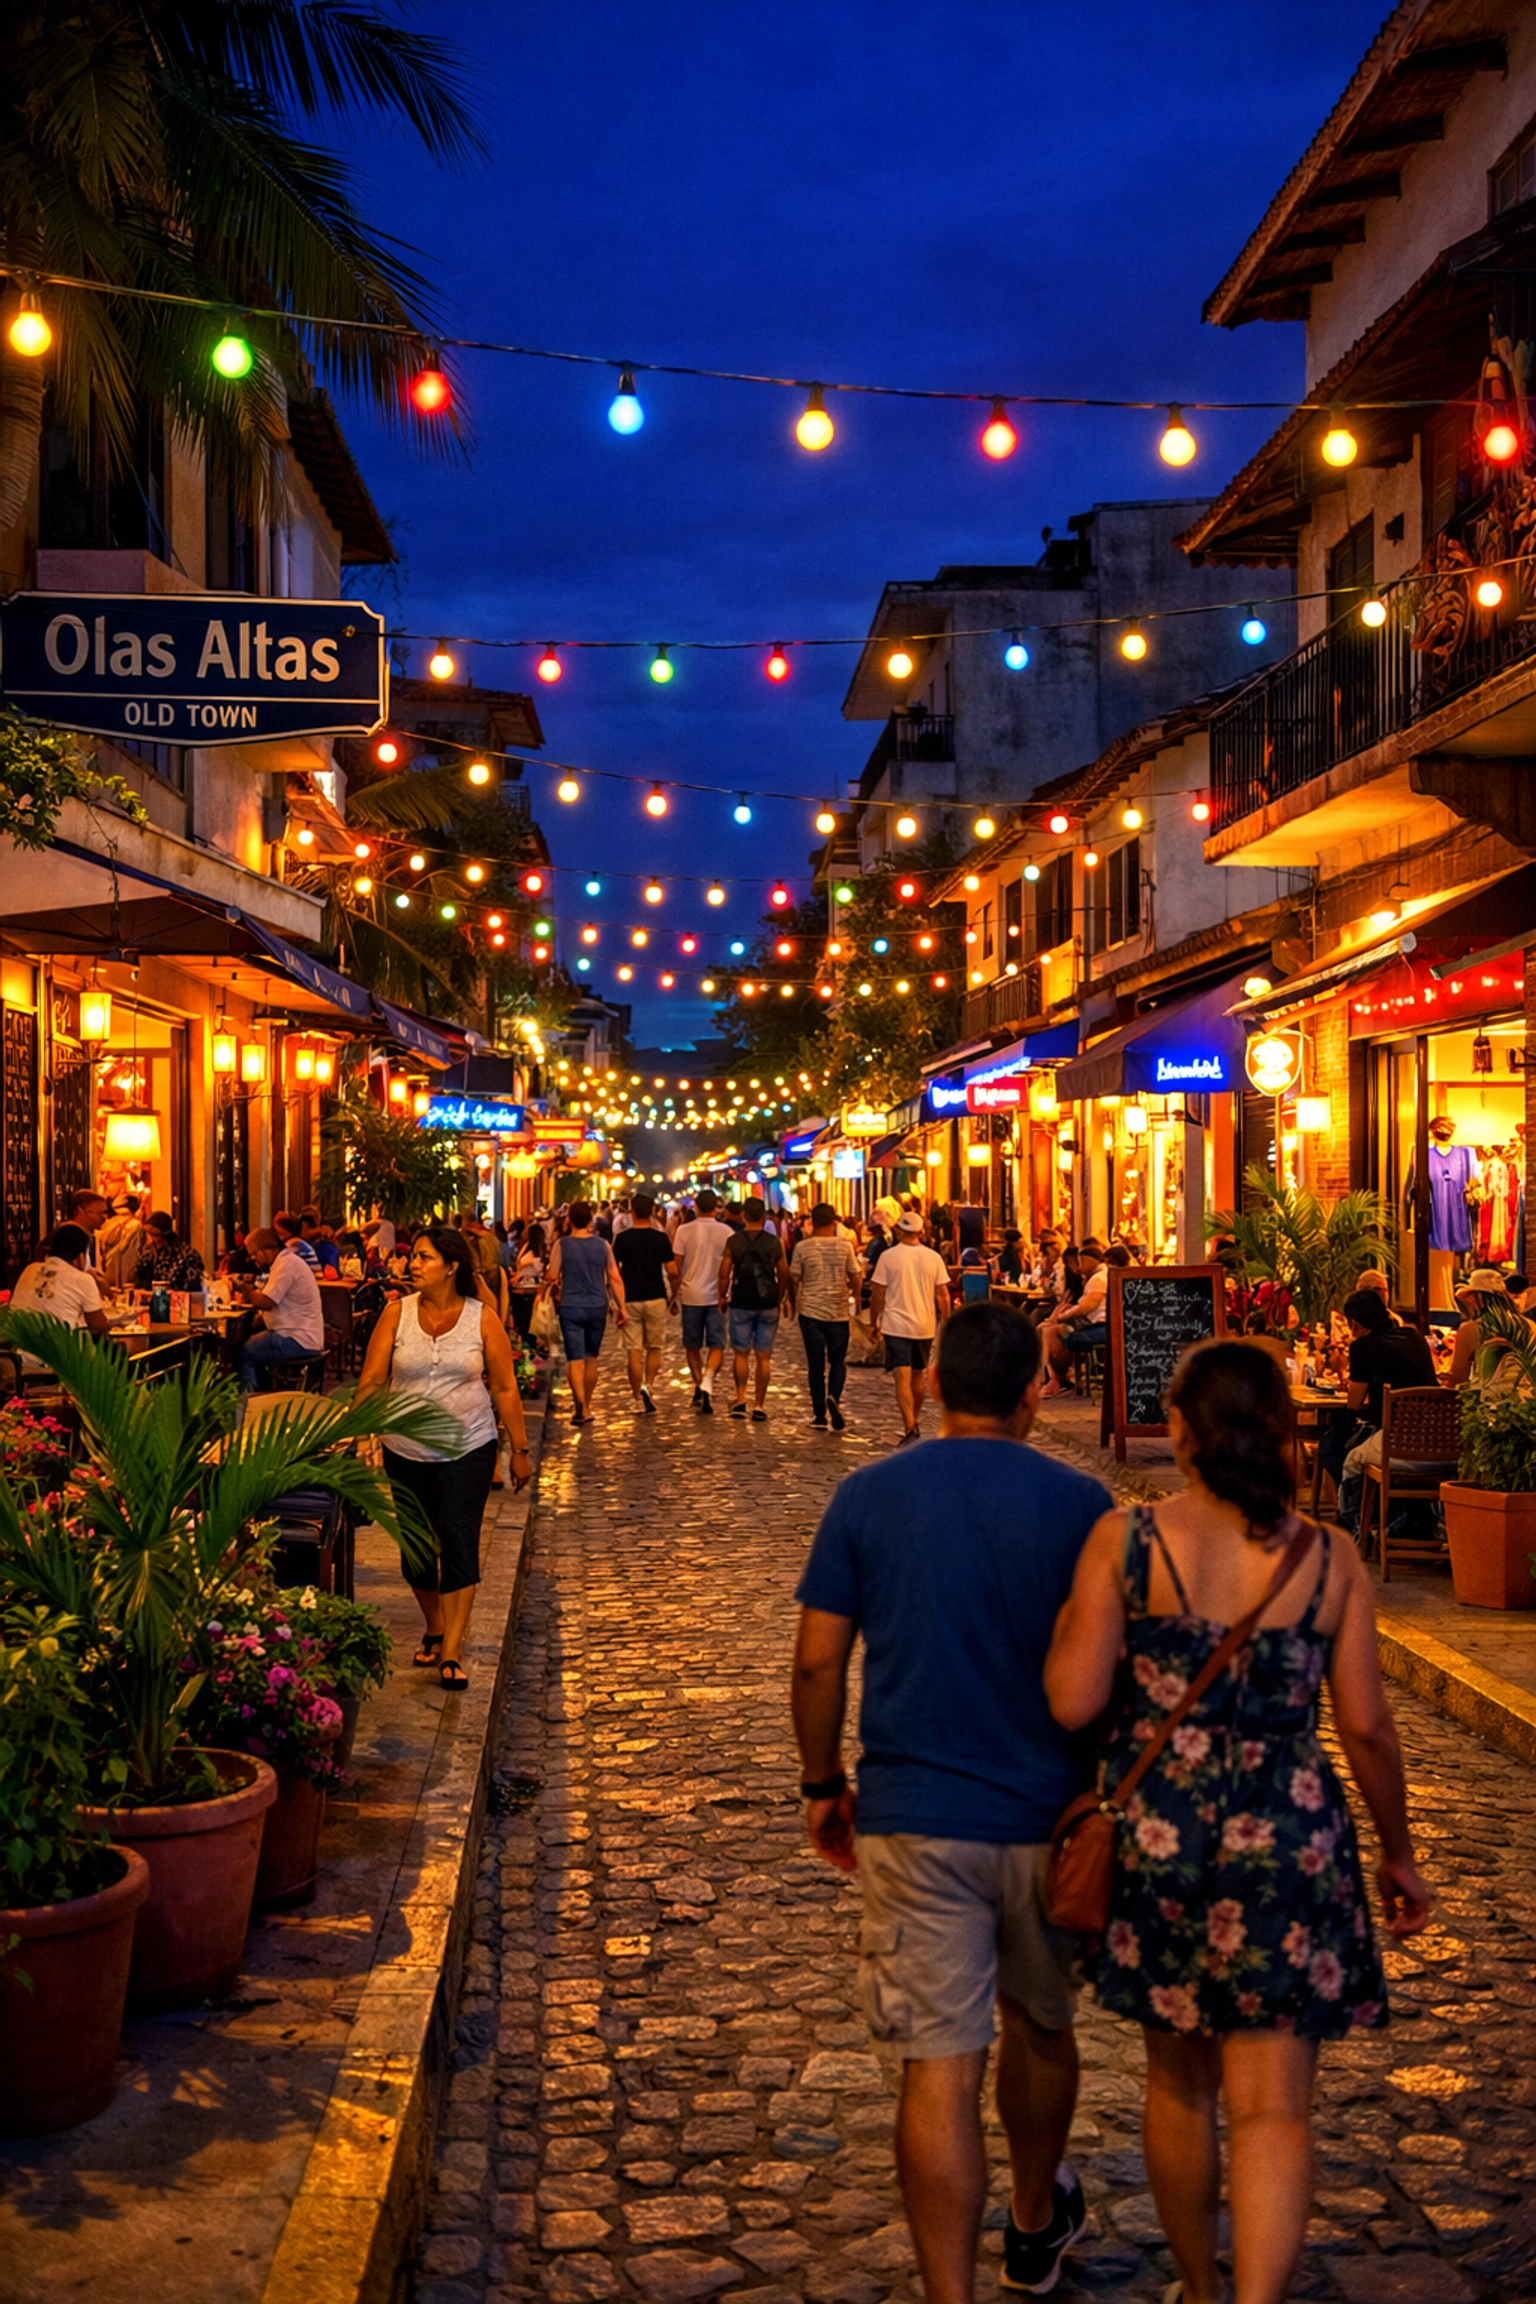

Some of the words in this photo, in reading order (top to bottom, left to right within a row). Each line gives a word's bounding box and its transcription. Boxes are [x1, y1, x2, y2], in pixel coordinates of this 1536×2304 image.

[45, 614, 176, 677] Olas
[196, 620, 340, 682] Altas
[124, 702, 175, 726] OLD
[187, 705, 257, 728] TOWN
